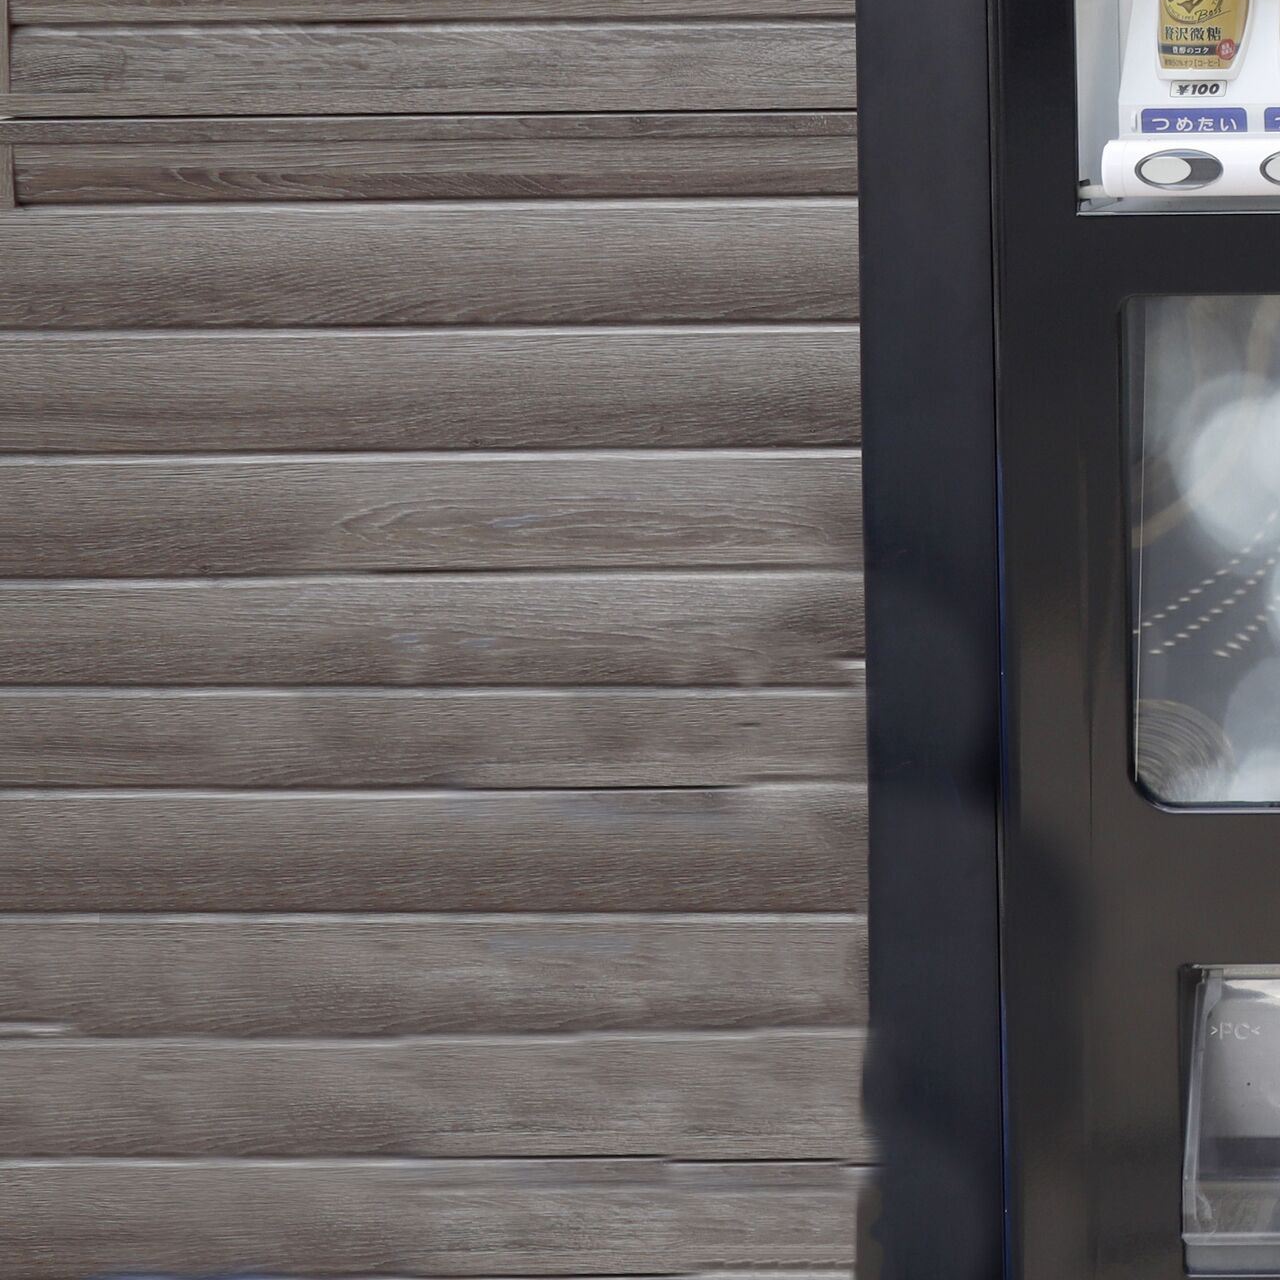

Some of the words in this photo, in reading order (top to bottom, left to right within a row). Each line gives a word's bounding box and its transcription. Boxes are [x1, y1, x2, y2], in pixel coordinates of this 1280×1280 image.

[1165, 27, 1221, 41] 贅沢微糖
[1177, 83, 1220, 95] ¥100
[1151, 116, 1237, 132] つめたい
